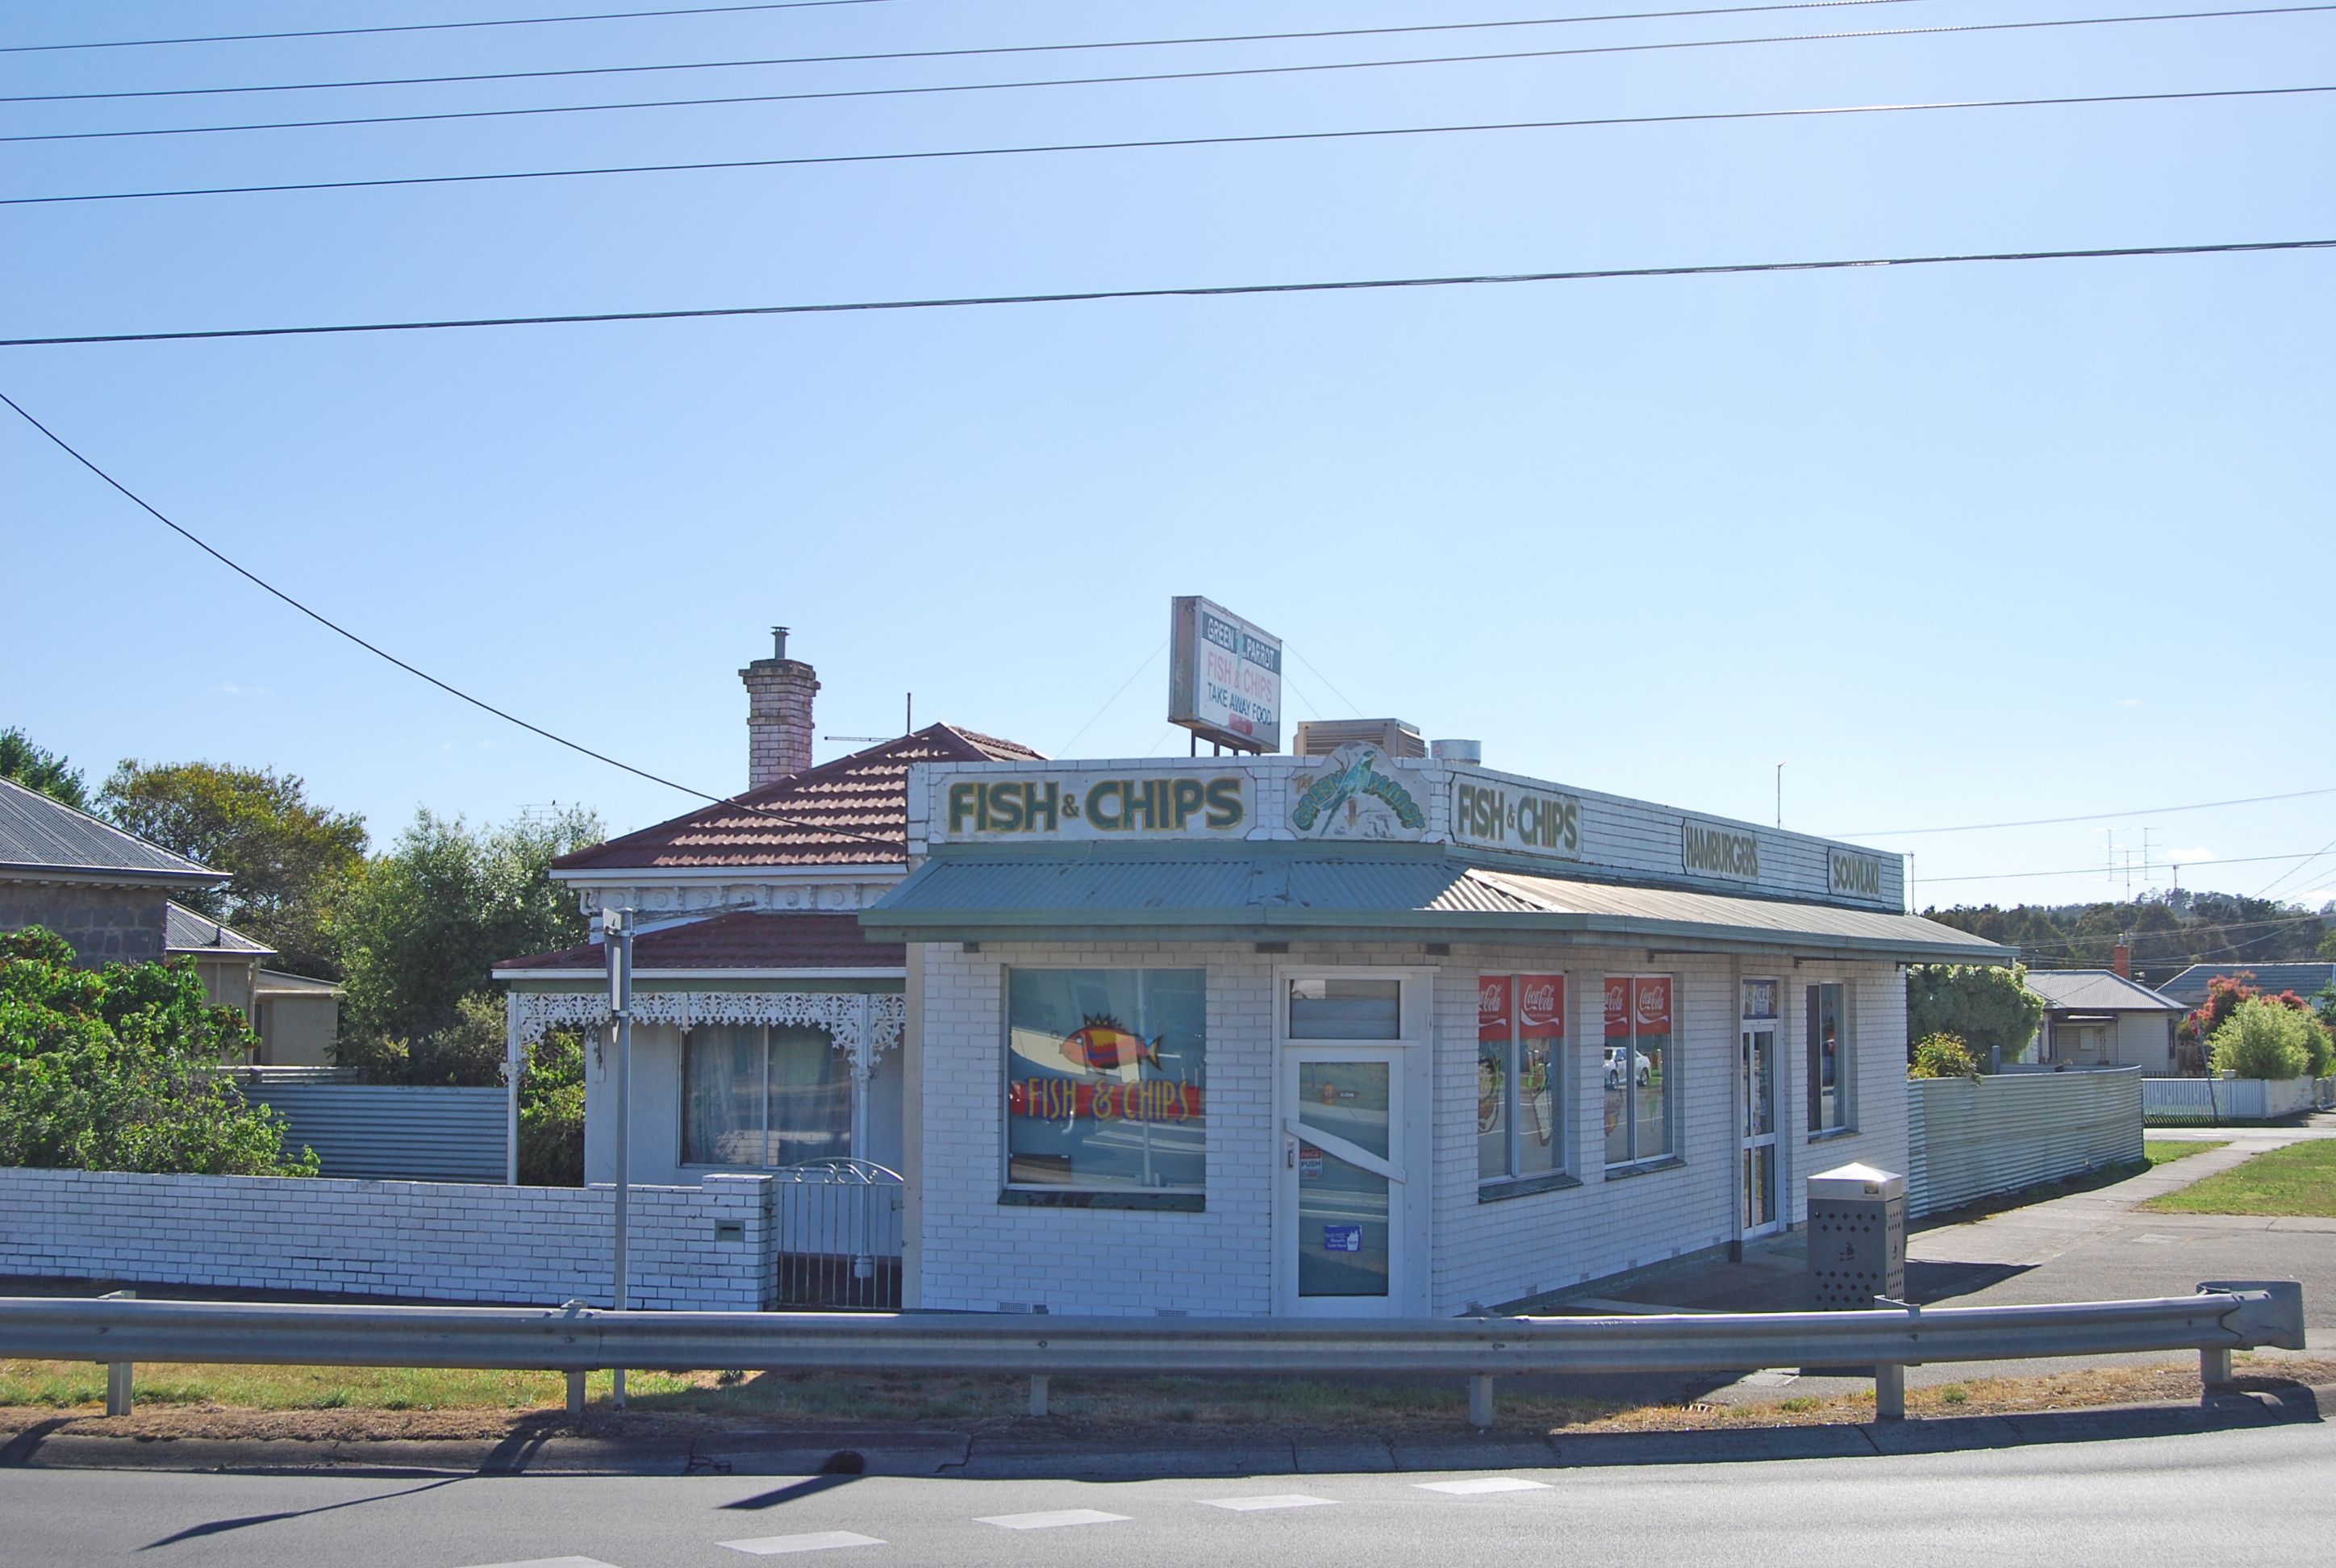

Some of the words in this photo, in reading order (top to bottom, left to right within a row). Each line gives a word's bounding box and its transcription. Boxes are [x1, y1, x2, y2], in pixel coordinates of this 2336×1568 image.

[1208, 618, 1233, 650] GREEN
[1247, 637, 1274, 669] PARROT
[1208, 651, 1231, 686] FISH
[1235, 670, 1241, 690] &
[1245, 669, 1272, 703] CHIPS
[1208, 682, 1228, 707] TAKE
[1229, 694, 1250, 716] AWAY
[1252, 703, 1272, 726] FOOD
[949, 781, 1059, 833] FISH
[1061, 793, 1080, 819] &
[1085, 777, 1245, 832] CHIPS
[1458, 782, 1504, 842] FISH
[1507, 803, 1515, 830] &
[1517, 794, 1578, 851] CHIPS
[1685, 825, 1758, 878] HAMBURGERS
[1833, 854, 1879, 894] SOUVLAKI
[1524, 984, 1555, 1011] Coca-Cola
[1639, 986, 1665, 1011] Coca-Cola
[1028, 1076, 1077, 1120] FISH
[1092, 1078, 1115, 1120] &
[1124, 1078, 1190, 1124] CHIPS
